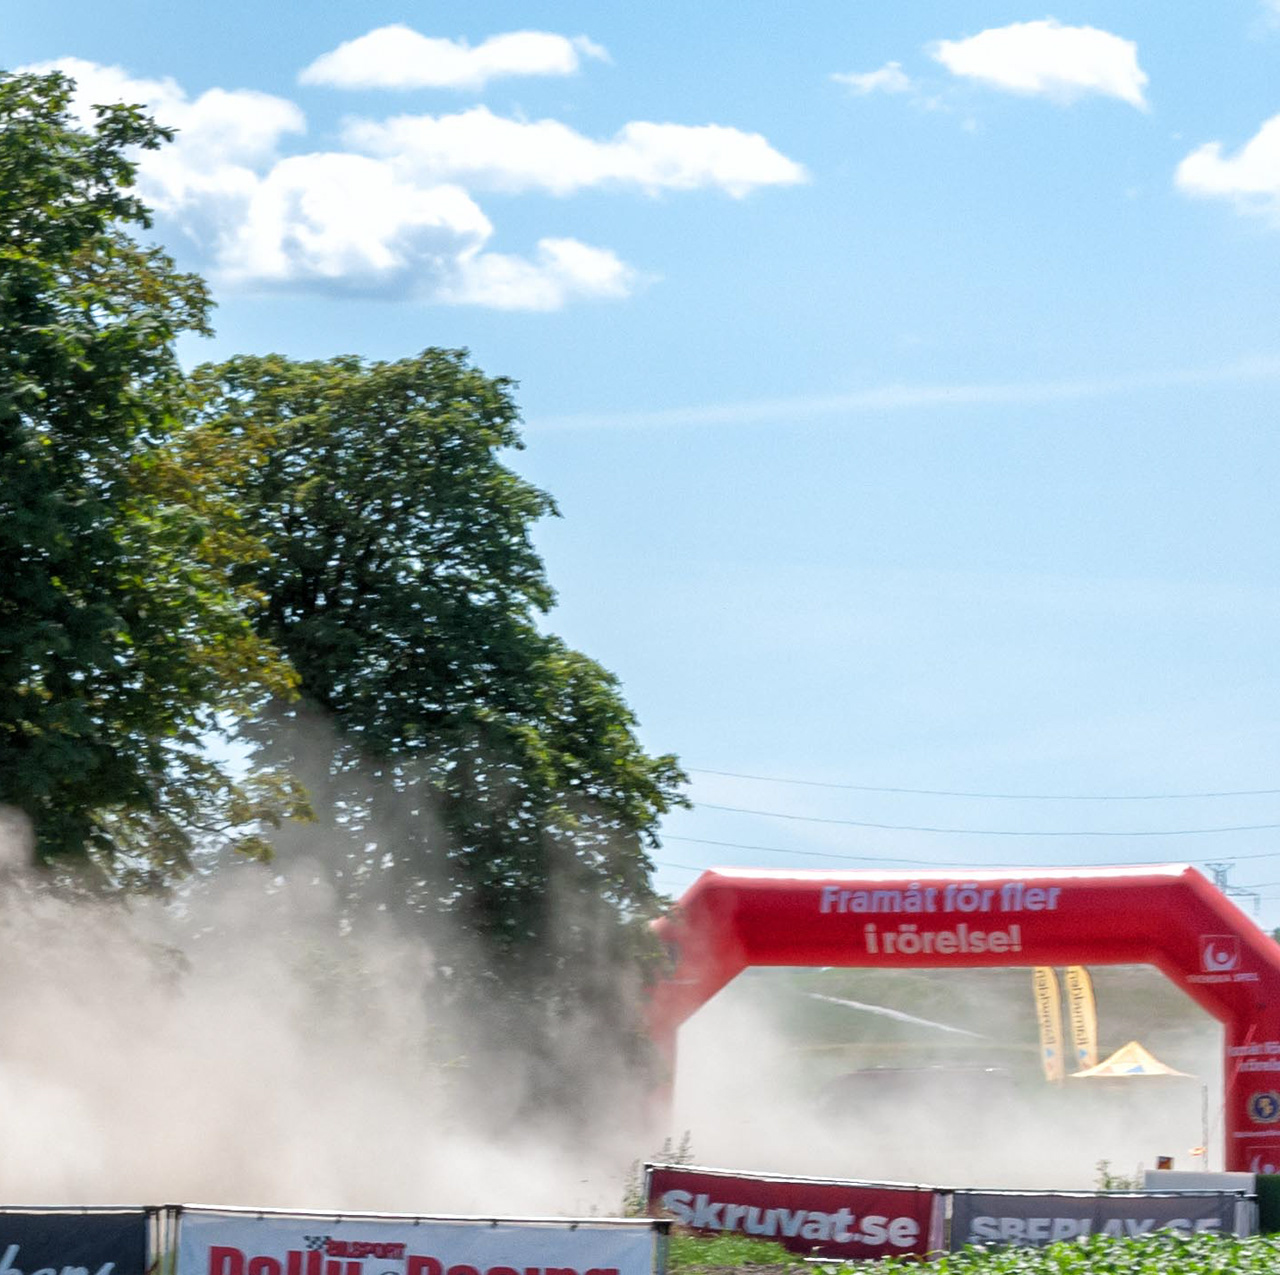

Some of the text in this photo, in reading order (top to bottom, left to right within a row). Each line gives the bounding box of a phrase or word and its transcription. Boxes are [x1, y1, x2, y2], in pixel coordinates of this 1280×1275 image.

[820, 882, 1061, 913] Framåt för fler
[864, 923, 1023, 954] i rörelse!
[660, 1189, 921, 1248] Skruvat.se
[969, 1215, 1223, 1243] SBEPLAYSE
